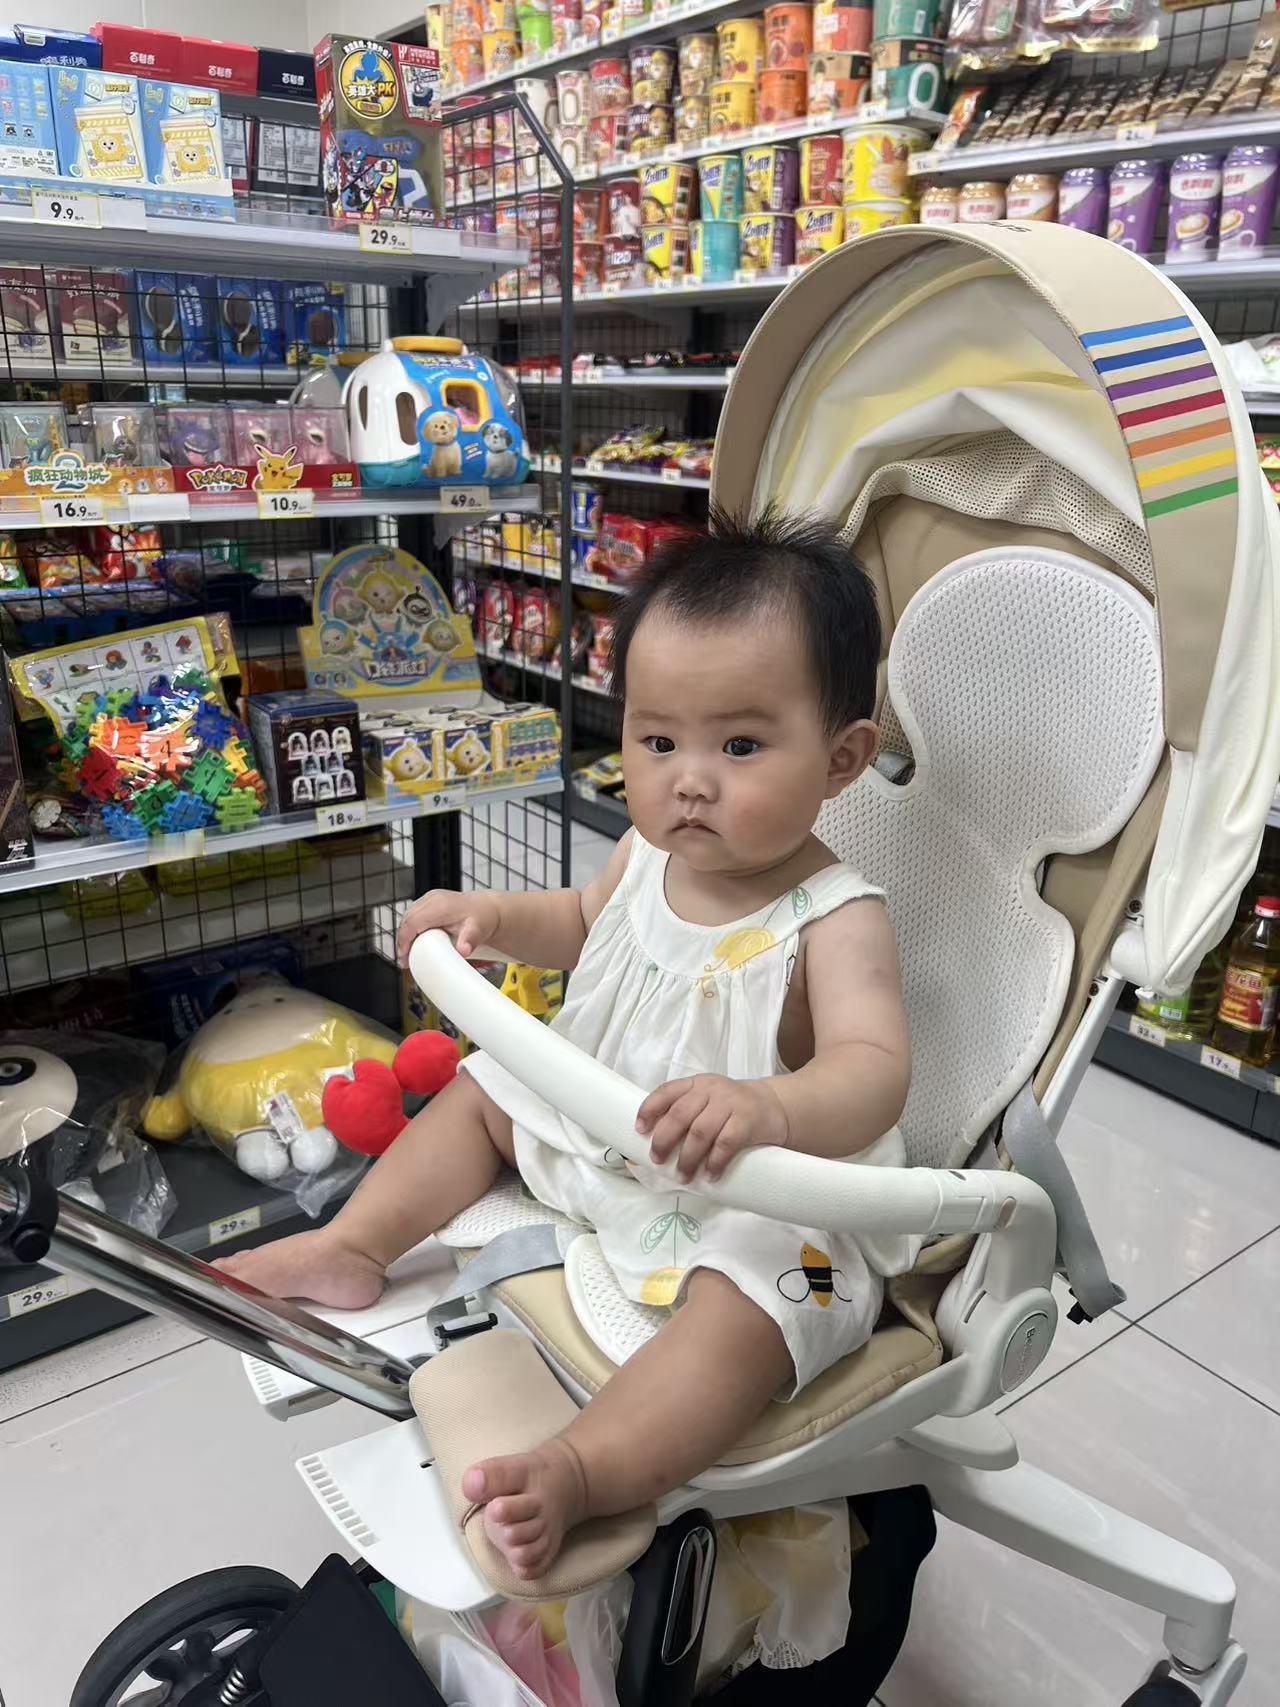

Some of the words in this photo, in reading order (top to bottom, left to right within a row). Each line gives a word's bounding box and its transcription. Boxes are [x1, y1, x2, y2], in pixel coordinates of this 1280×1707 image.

[50, 201, 74, 220] 9.9
[370, 229, 398, 246] 29.9
[27, 468, 110, 482] 疯狂动物城
[53, 502, 88, 518] 16.9
[270, 497, 298, 511] 10.9
[21, 1288, 54, 1307] 29.9
